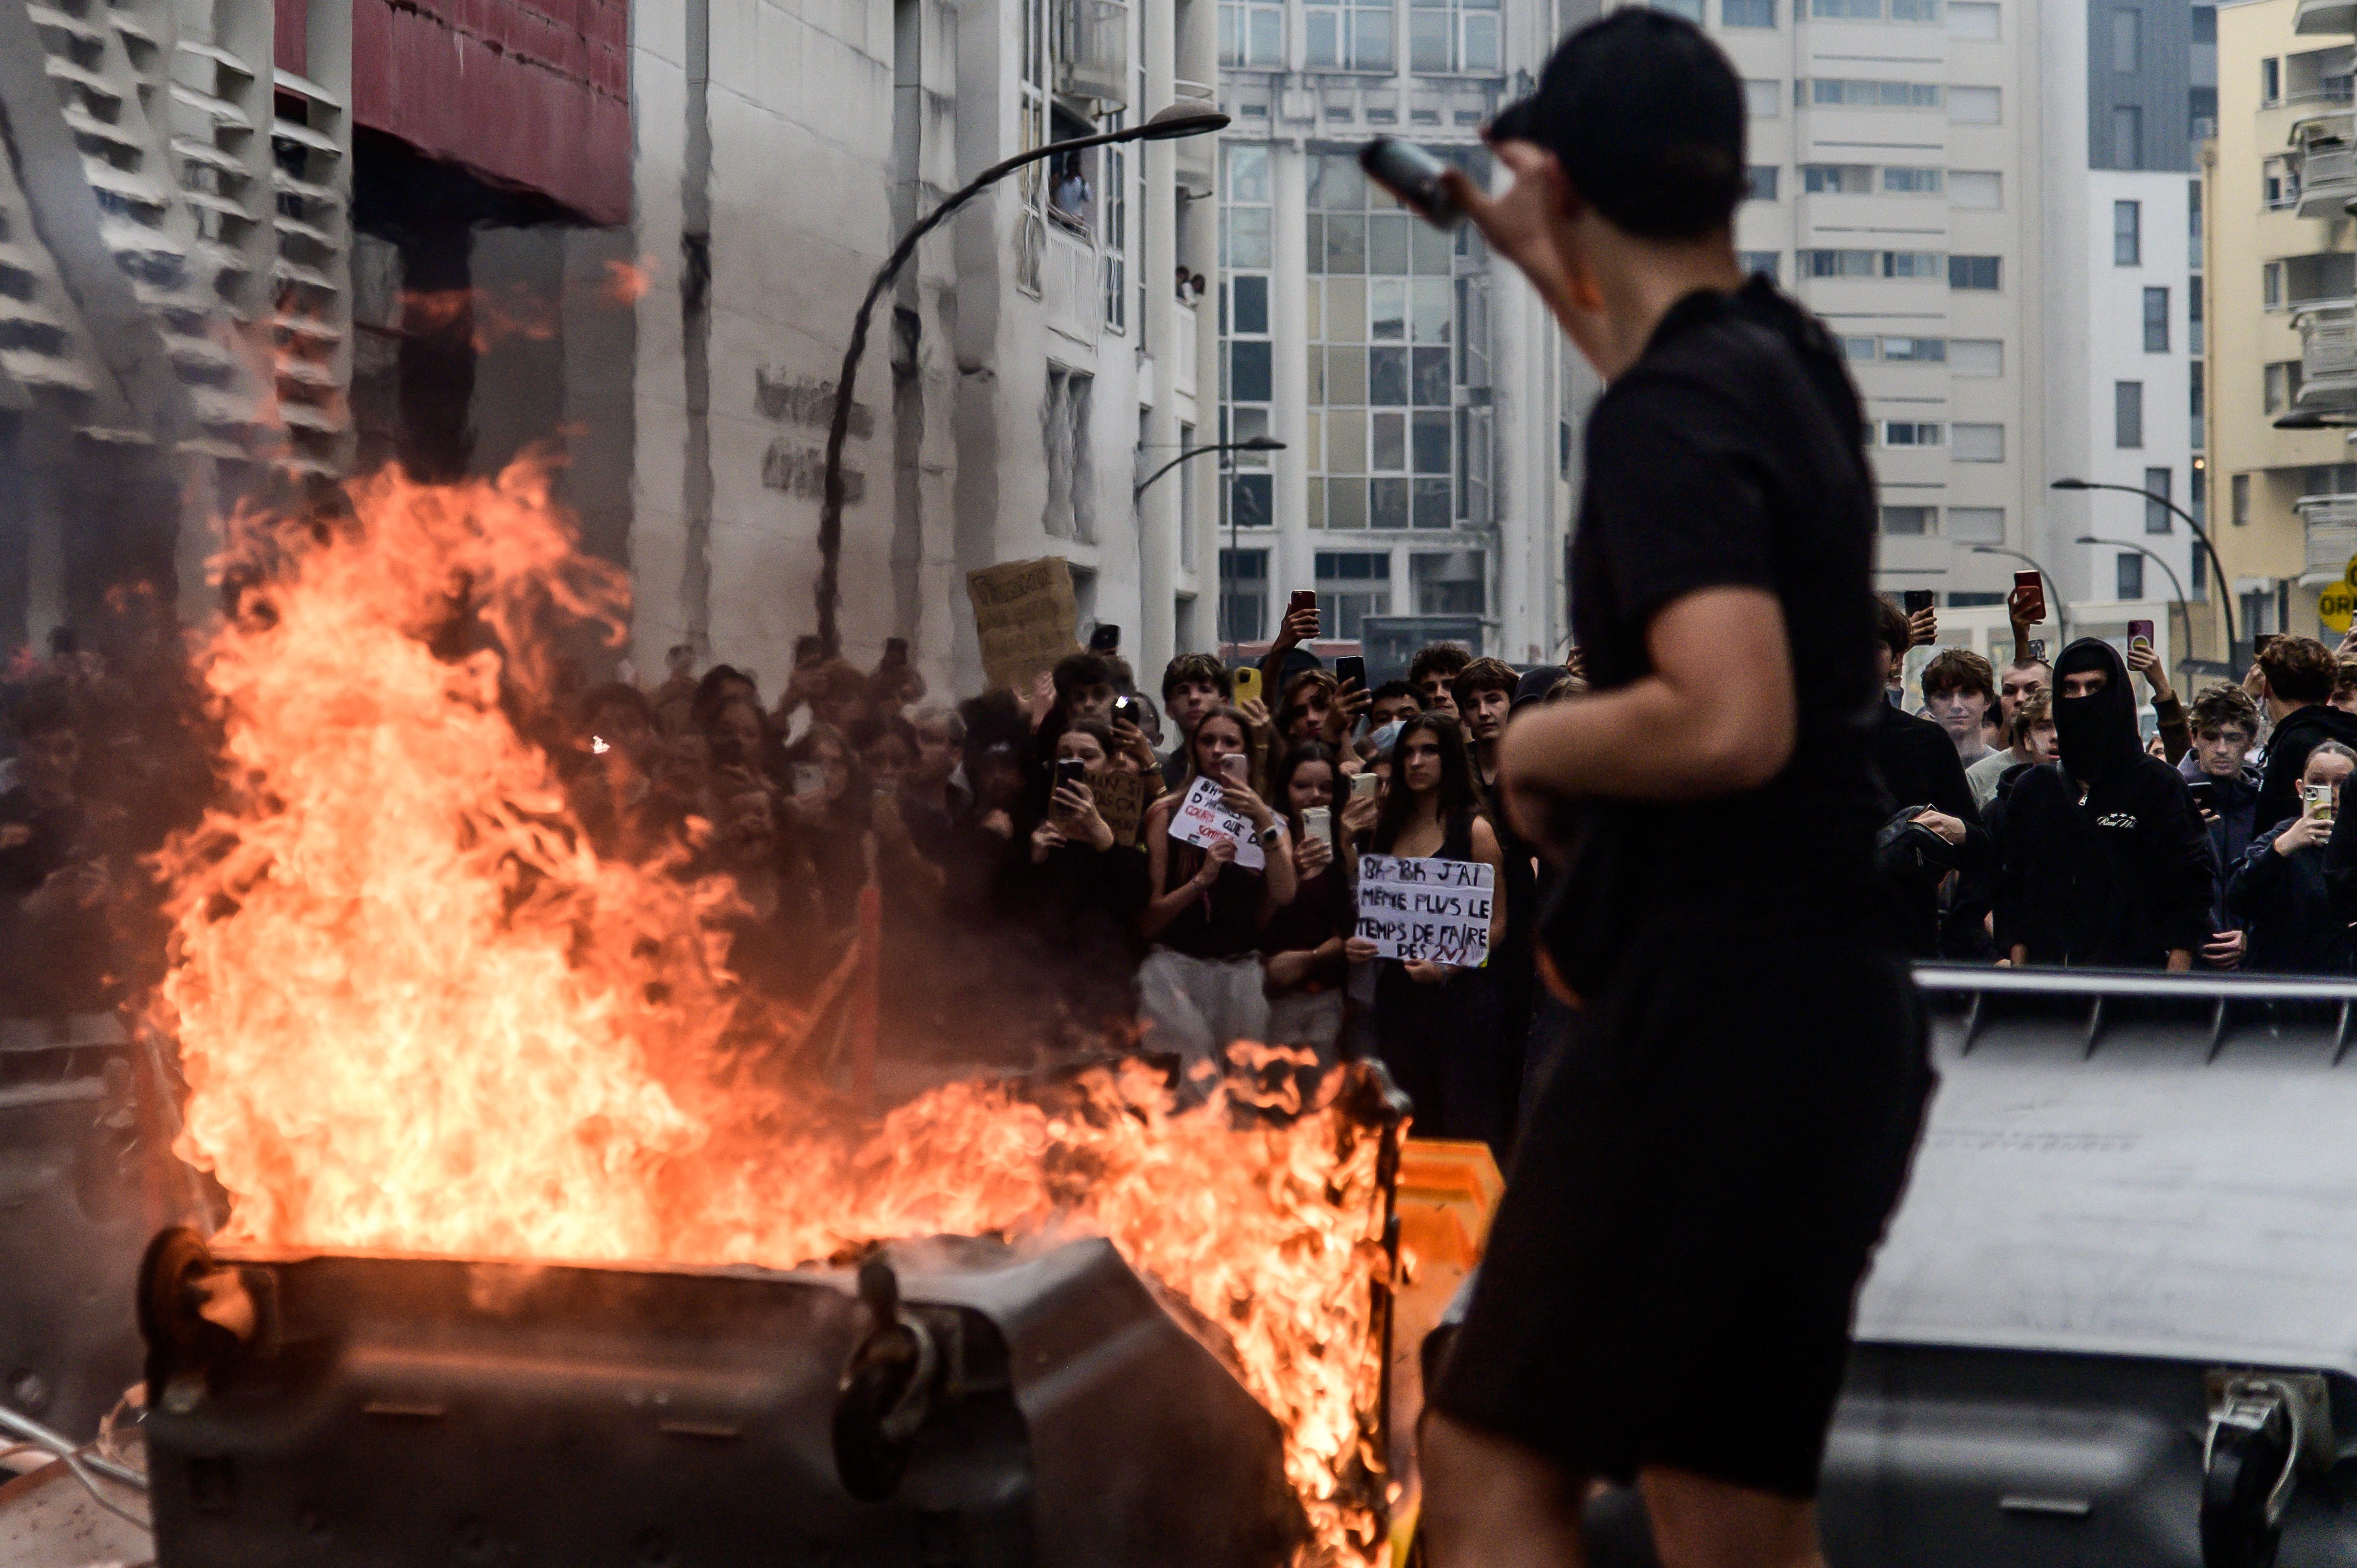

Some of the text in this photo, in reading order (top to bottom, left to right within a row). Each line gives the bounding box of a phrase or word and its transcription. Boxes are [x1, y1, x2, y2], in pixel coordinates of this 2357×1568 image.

[1223, 820, 1245, 837] QUE
[1361, 886, 1489, 919] MÊME PLUS LE
[1357, 917, 1487, 948] TEMPS DE FAIRE
[1397, 944, 1426, 960] DES
